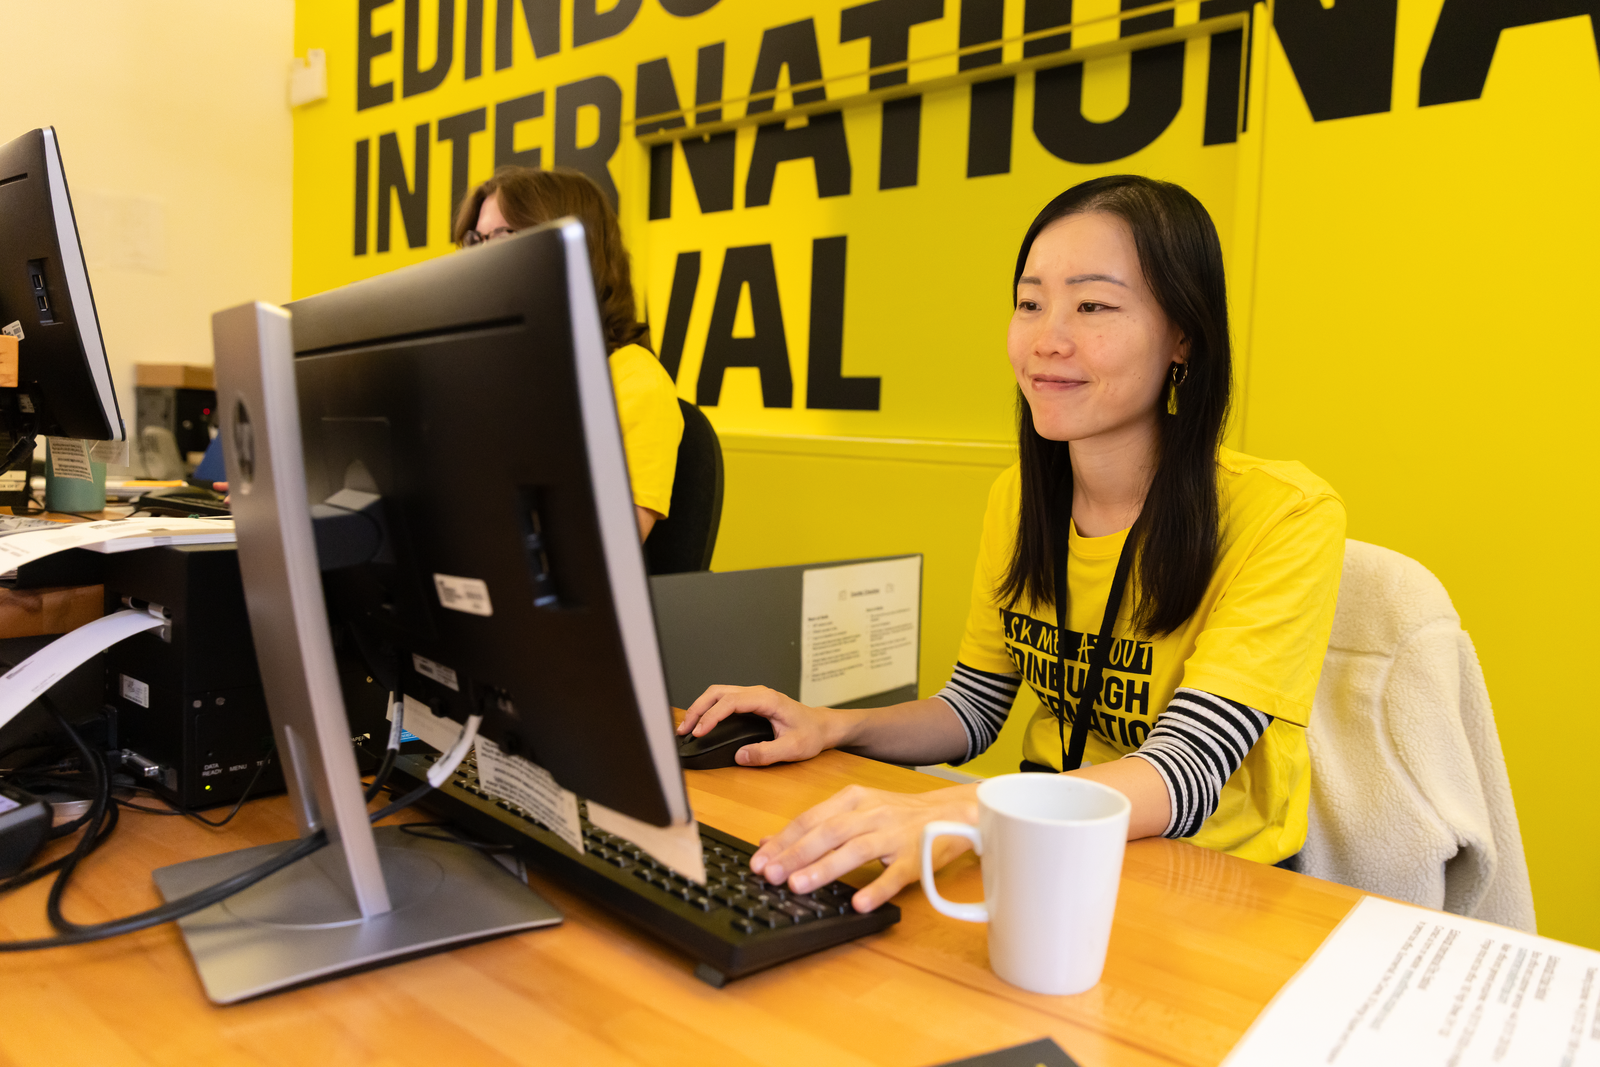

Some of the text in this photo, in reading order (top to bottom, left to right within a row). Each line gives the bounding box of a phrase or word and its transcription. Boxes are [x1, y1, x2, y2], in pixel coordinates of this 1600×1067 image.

[1077, 632, 1153, 670] AOUT
[204, 763, 219, 771] DATA
[229, 764, 248, 772] MENU
[202, 768, 223, 777] READY
